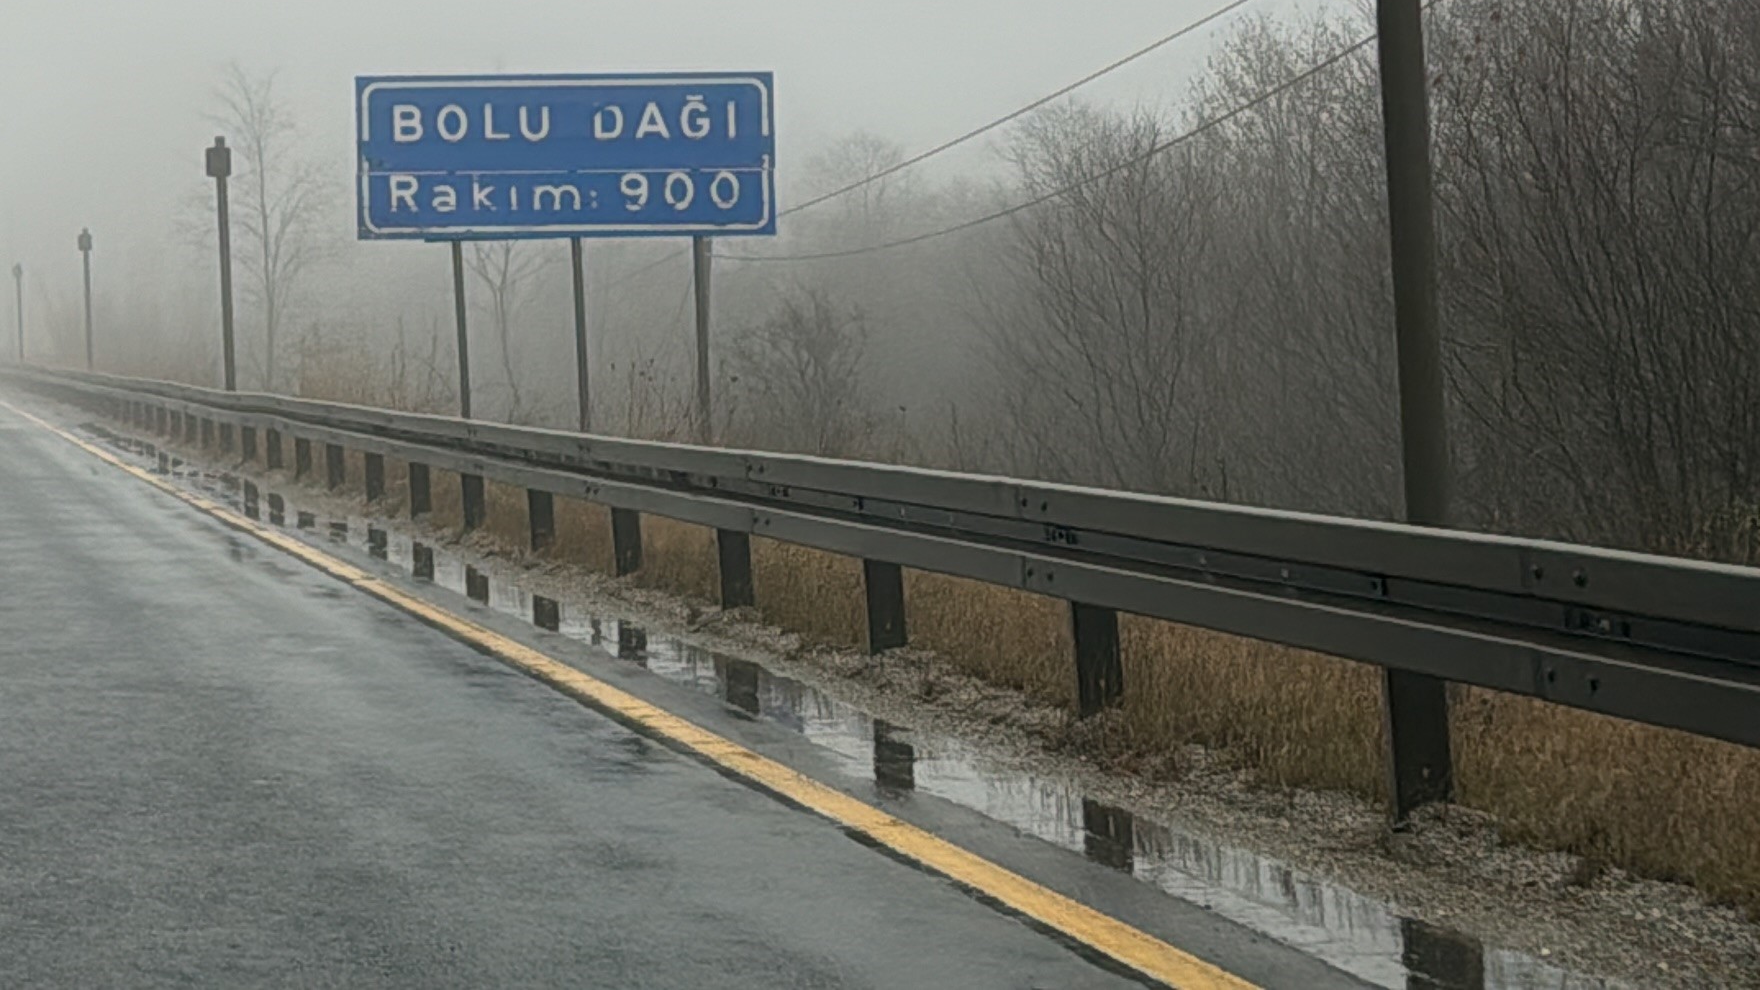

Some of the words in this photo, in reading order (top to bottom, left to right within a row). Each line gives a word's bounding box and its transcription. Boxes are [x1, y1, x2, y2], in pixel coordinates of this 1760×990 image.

[392, 103, 550, 142] BOLU
[593, 95, 736, 140] DAĞI
[389, 174, 598, 212] Rakım:
[620, 172, 740, 211] 900
